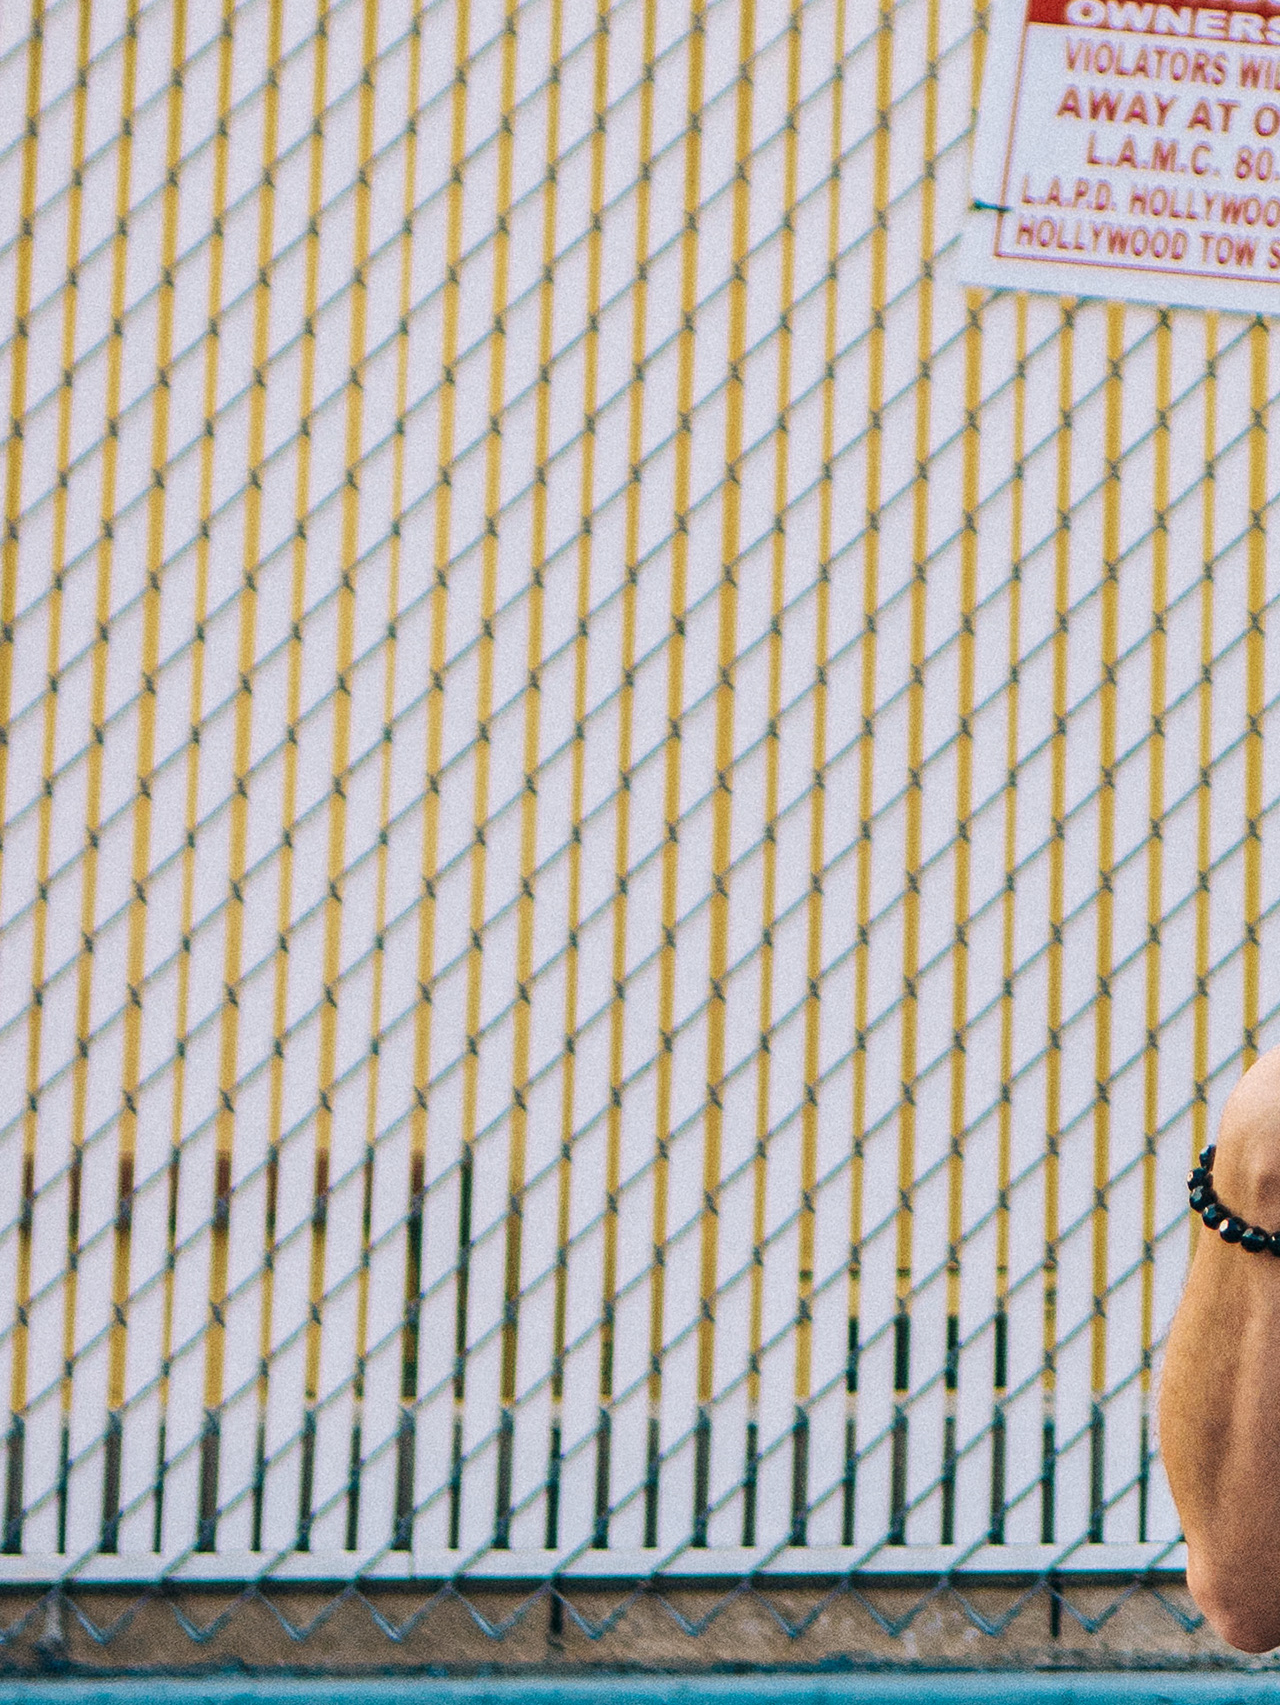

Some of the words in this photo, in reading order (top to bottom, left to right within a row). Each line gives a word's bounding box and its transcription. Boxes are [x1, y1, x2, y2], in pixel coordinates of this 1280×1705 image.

[1064, 41, 1226, 88] VIOLATORS
[1055, 87, 1175, 129] AWAY
[1185, 99, 1239, 134] AT
[1015, 218, 1188, 263] HOLLYWOOD
[1199, 233, 1257, 268] TOW
